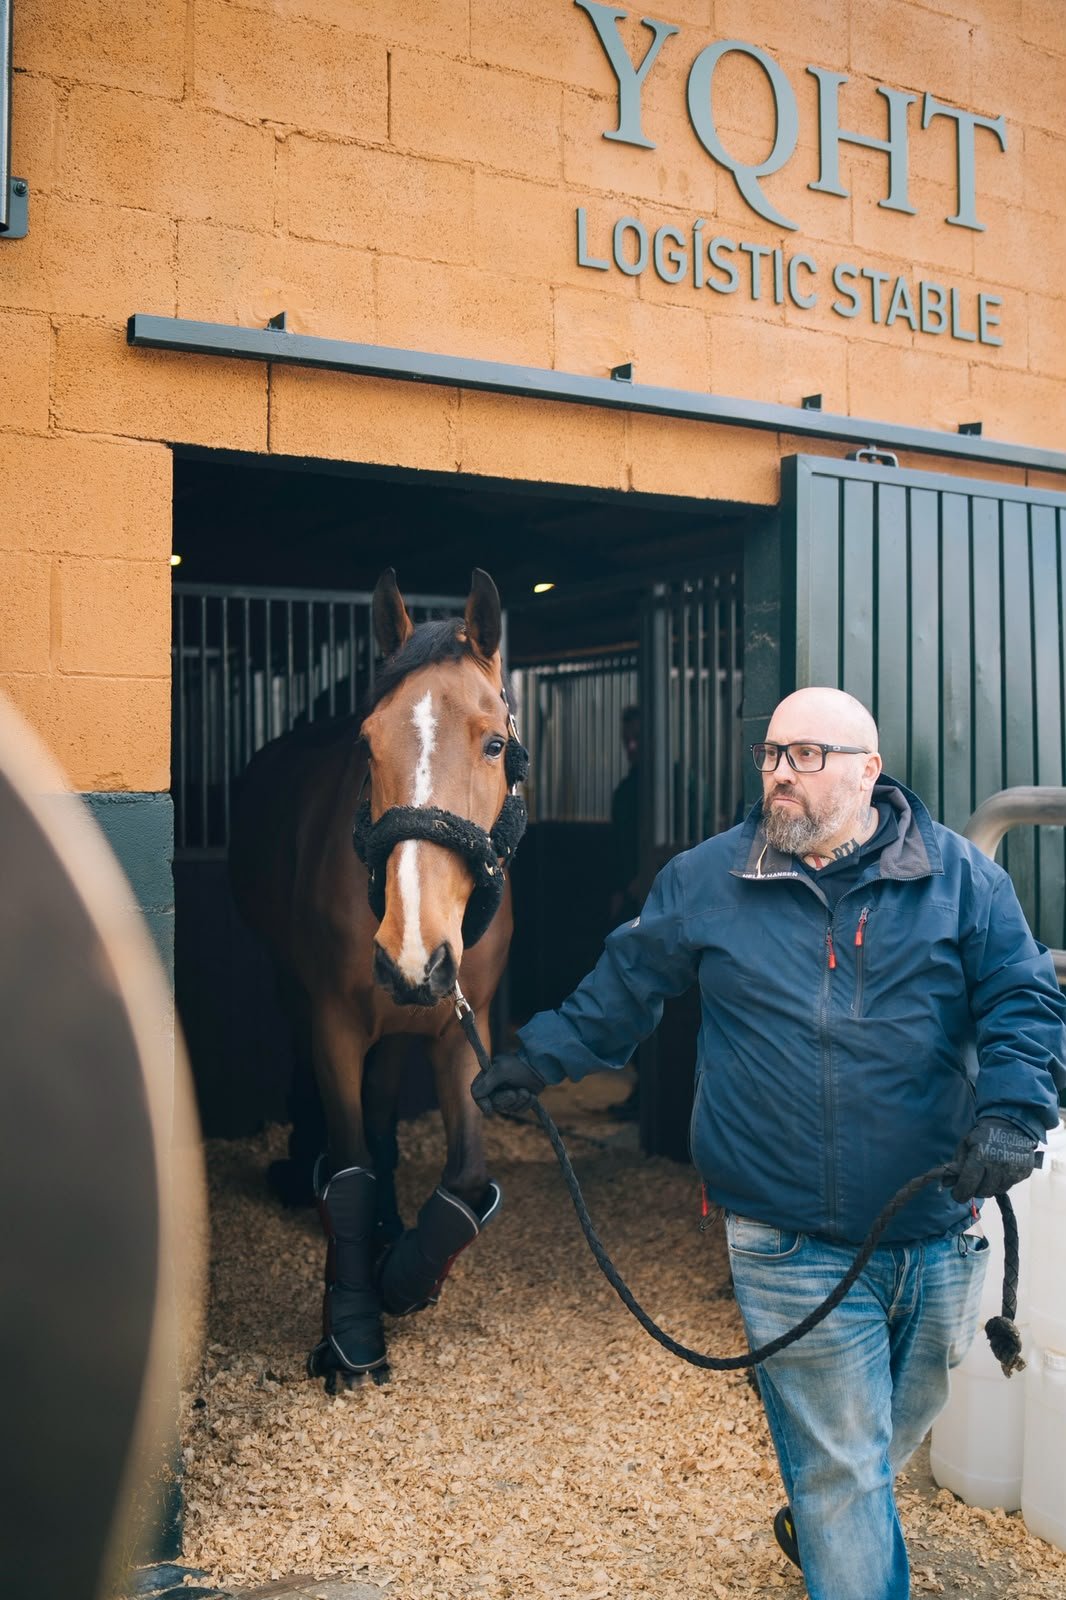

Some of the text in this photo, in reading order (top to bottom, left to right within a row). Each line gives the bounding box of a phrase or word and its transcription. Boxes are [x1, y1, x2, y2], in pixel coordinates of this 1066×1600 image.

[575, 0, 1007, 232] YQHT
[575, 207, 1004, 347] LOGÍSTIC STABLE
